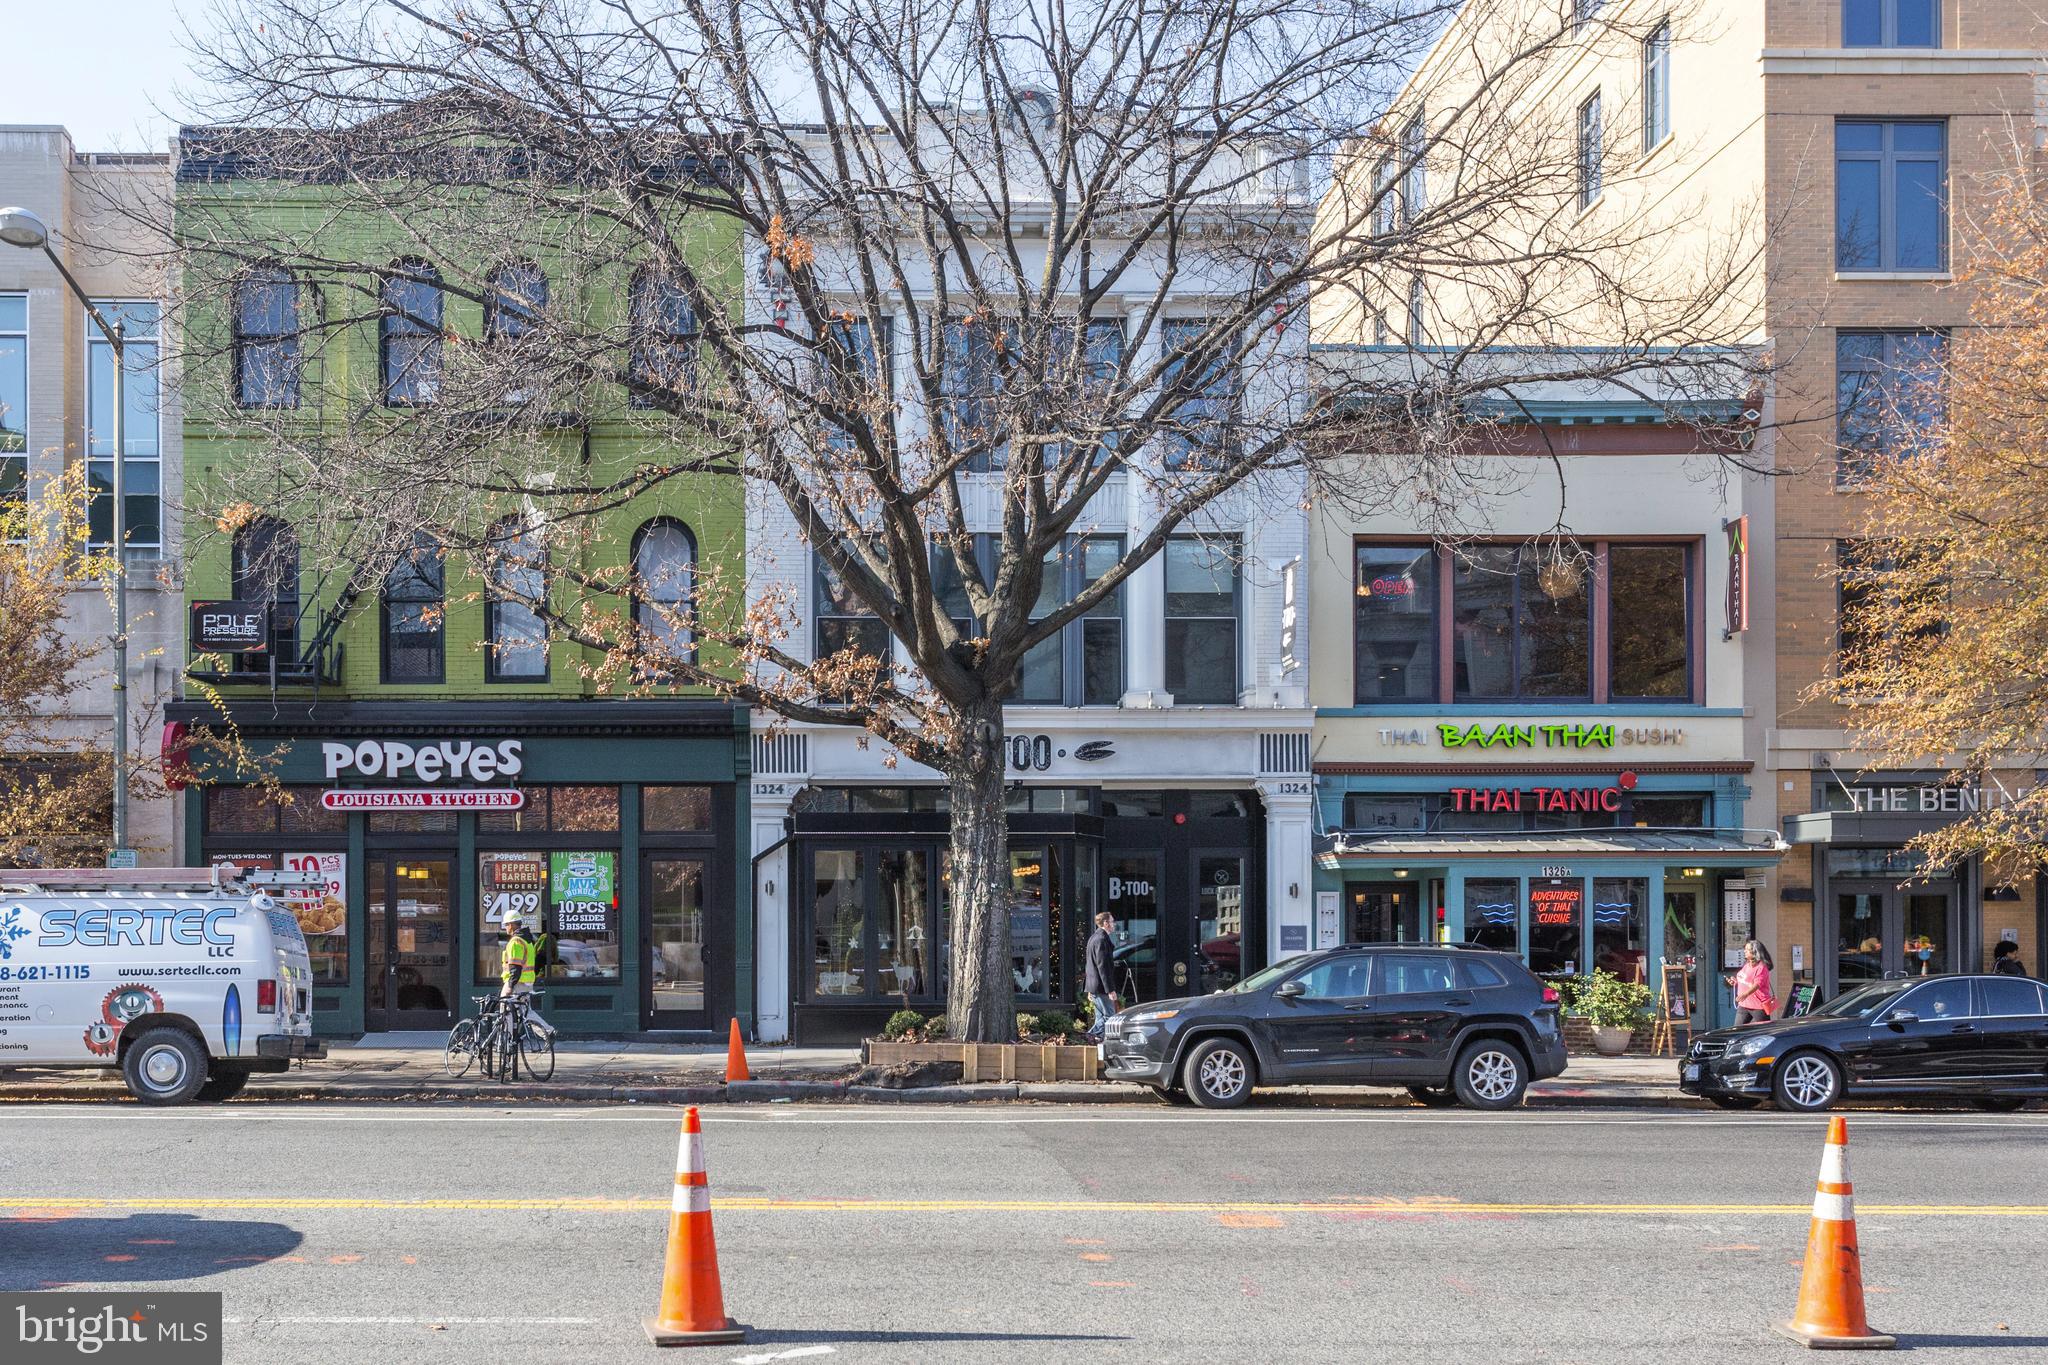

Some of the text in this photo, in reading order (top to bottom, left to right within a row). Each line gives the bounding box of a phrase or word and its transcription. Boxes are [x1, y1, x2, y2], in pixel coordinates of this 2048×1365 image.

[203, 614, 258, 628] POLE
[203, 627, 259, 635] PRESSURE
[1378, 723, 1683, 748] THAI BAAN THAI SUSHI
[756, 784, 784, 795] 1324
[1280, 783, 1308, 793] 1324
[332, 793, 513, 806] LOUISIANA KITCHEN
[1449, 787, 1622, 812] THAI TANIC
[1848, 788, 1908, 812] THE
[321, 855, 340, 865] PCS
[501, 863, 537, 872] PEPPER
[501, 873, 538, 881] BARREL
[568, 877, 597, 890] MVP
[564, 889, 600, 900] BUNDLE
[1531, 890, 1579, 901] ADVENTURES
[559, 900, 606, 914] 10 PCS
[1538, 902, 1571, 912] OF THAI
[558, 913, 565, 921] 2
[1538, 913, 1571, 923] CUISINE
[39, 907, 237, 947] SERTEC
[559, 922, 565, 930] 5
[208, 946, 234, 957] LLC
[118, 965, 241, 976] www.sertecllc.com
